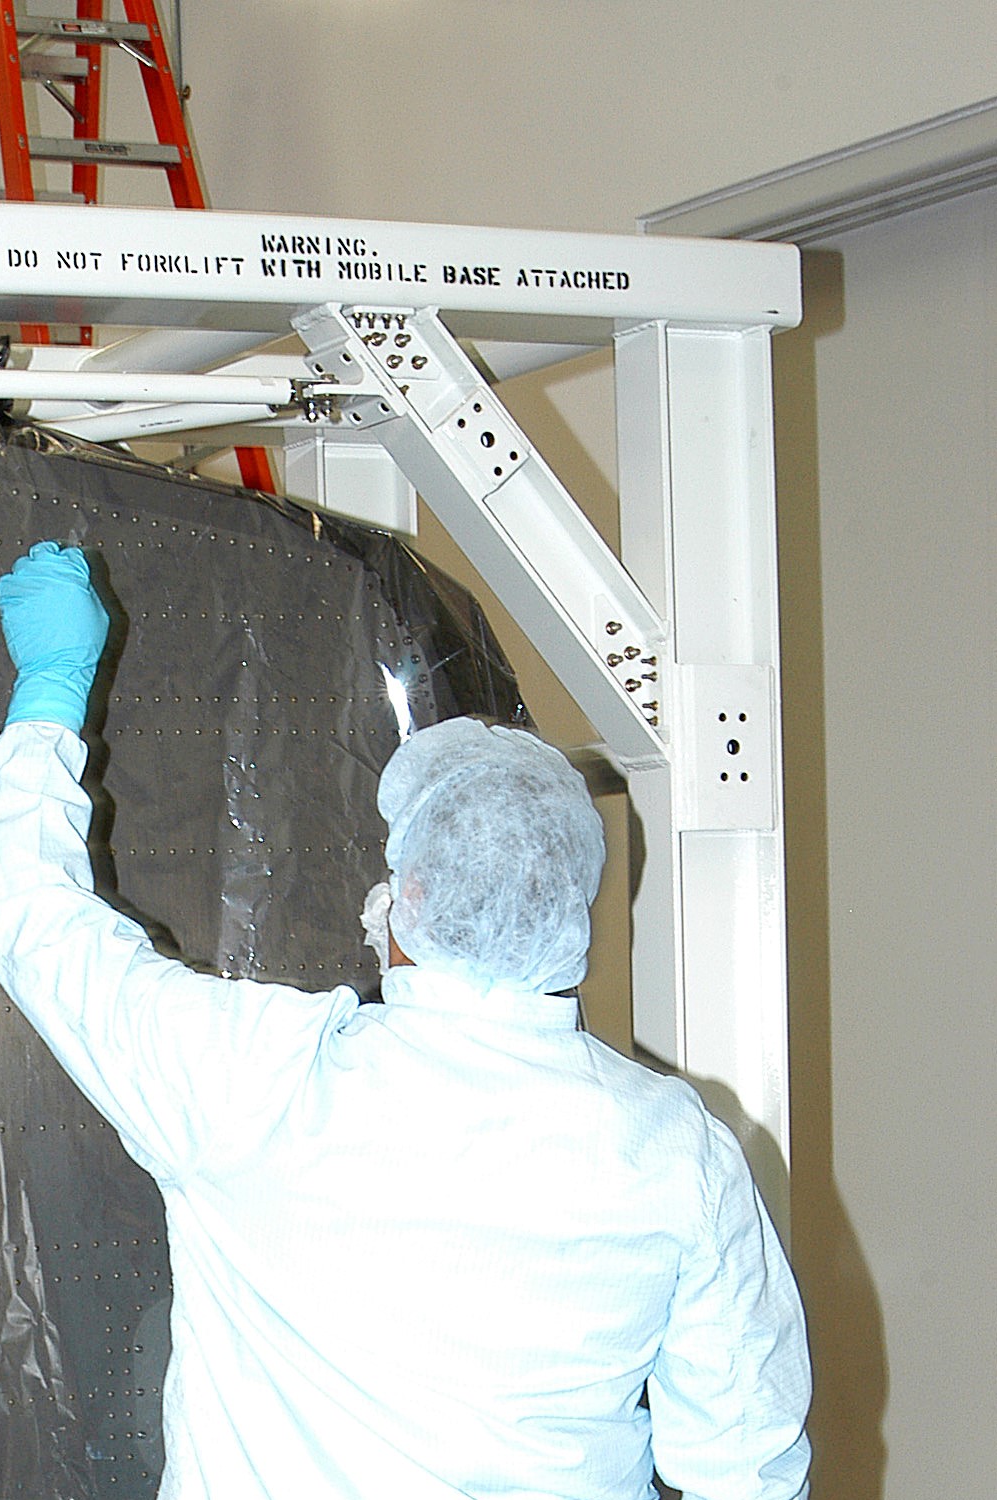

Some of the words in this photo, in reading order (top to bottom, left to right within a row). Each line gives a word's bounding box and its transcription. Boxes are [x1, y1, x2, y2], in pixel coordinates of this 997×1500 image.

[261, 234, 378, 257] WARNING.
[7, 248, 38, 268] DO
[56, 251, 102, 271] NOT
[121, 253, 245, 276] FORKLIFT
[260, 258, 321, 279] WITH
[337, 260, 428, 283] MOBILE
[442, 265, 501, 286] BASE
[516, 268, 630, 291] ATTACHED
